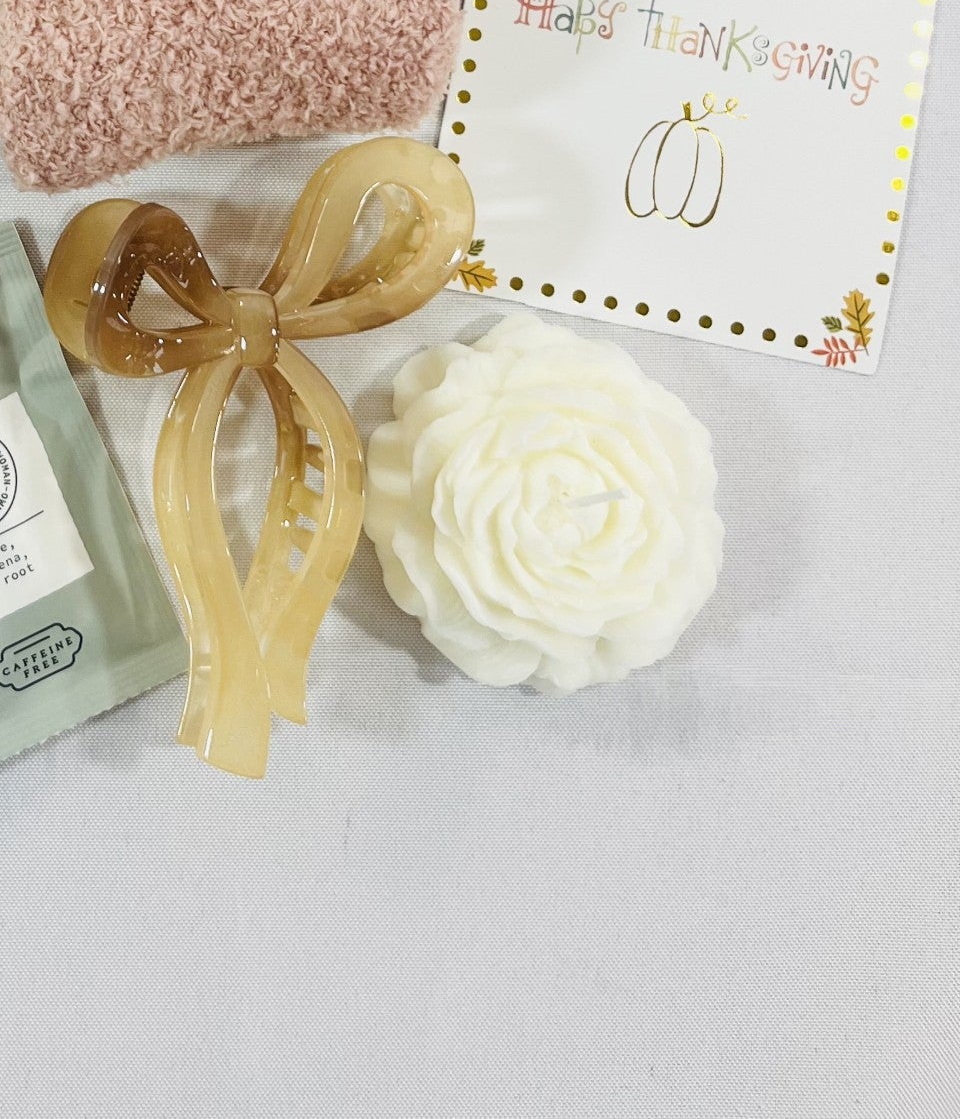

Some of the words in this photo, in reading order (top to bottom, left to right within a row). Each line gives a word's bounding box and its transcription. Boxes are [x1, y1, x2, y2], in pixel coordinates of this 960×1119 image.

[4, 563, 35, 584] root
[2, 636, 73, 675] CAFFEINE
[23, 655, 59, 678] FREE
